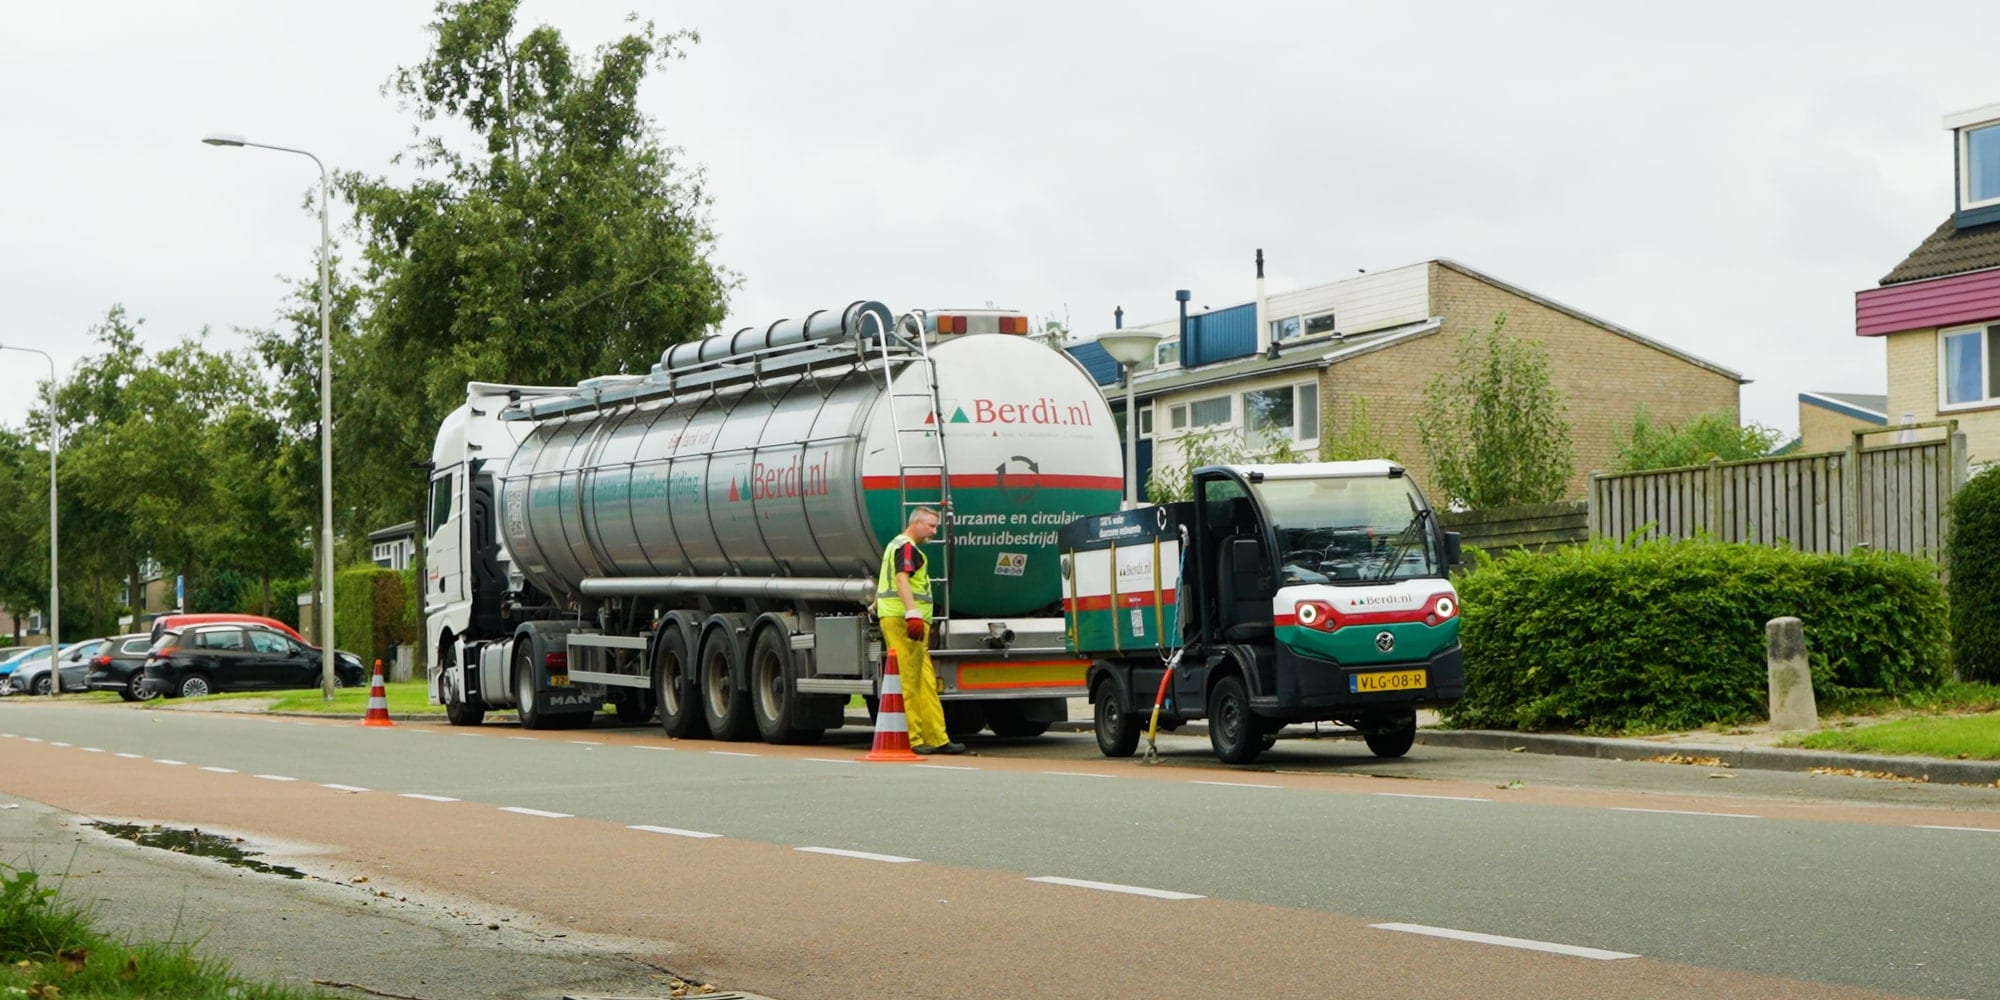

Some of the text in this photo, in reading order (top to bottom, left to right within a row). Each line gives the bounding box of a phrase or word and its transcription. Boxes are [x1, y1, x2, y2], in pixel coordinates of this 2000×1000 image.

[974, 398, 1092, 426] Berdi.nl
[754, 451, 828, 500] Berdi.nl
[1010, 514, 1027, 525] en
[1031, 510, 1085, 525] circulair
[949, 531, 1058, 548] onkruidbestrijdi
[1366, 594, 1412, 605] Berdi.nl
[1361, 673, 1422, 689] VLG-08-R
[550, 695, 591, 706] MAN
